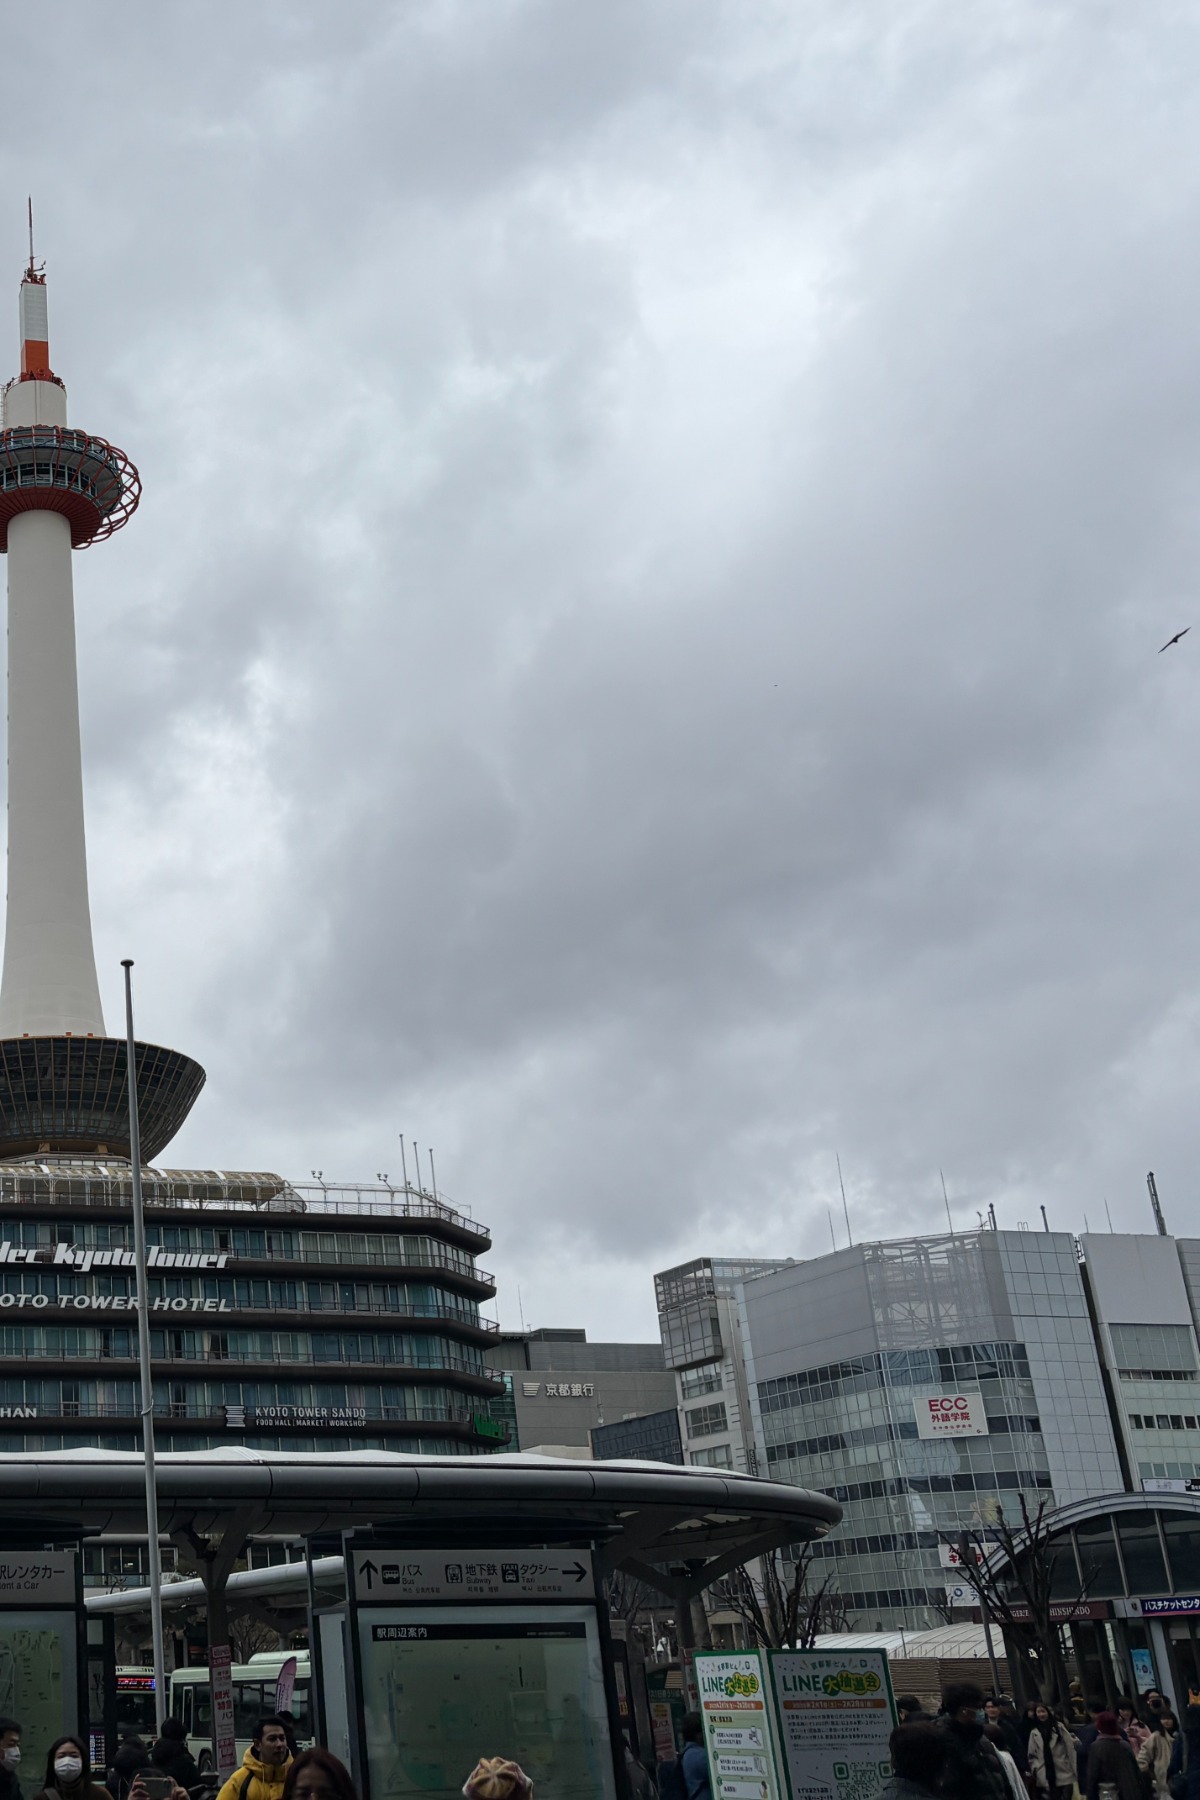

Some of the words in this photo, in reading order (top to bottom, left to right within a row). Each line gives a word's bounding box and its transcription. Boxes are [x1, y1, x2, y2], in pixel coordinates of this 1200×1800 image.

[53, 1243, 137, 1273] Kyoto
[146, 1245, 230, 1269] Tower
[58, 1294, 140, 1310] TOWER
[153, 1297, 232, 1312] HOTEL
[545, 1383, 594, 1397] 京都銀行
[928, 1397, 968, 1412] ECC
[255, 1407, 288, 1417] KYOTO
[292, 1407, 327, 1417] TOWER
[332, 1408, 366, 1418] SANDO
[931, 1412, 971, 1423] 外語学院
[296, 1419, 324, 1427] MARKET
[401, 1564, 423, 1576] バス
[465, 1563, 498, 1576] 地下鉄
[520, 1563, 559, 1575] タクシー
[24, 1581, 40, 1590] Car
[402, 1577, 415, 1585] Bus
[466, 1577, 491, 1586] Subway
[1145, 1598, 1200, 1611] バスチケットセンタ
[377, 1627, 428, 1639] 駅周辺案内
